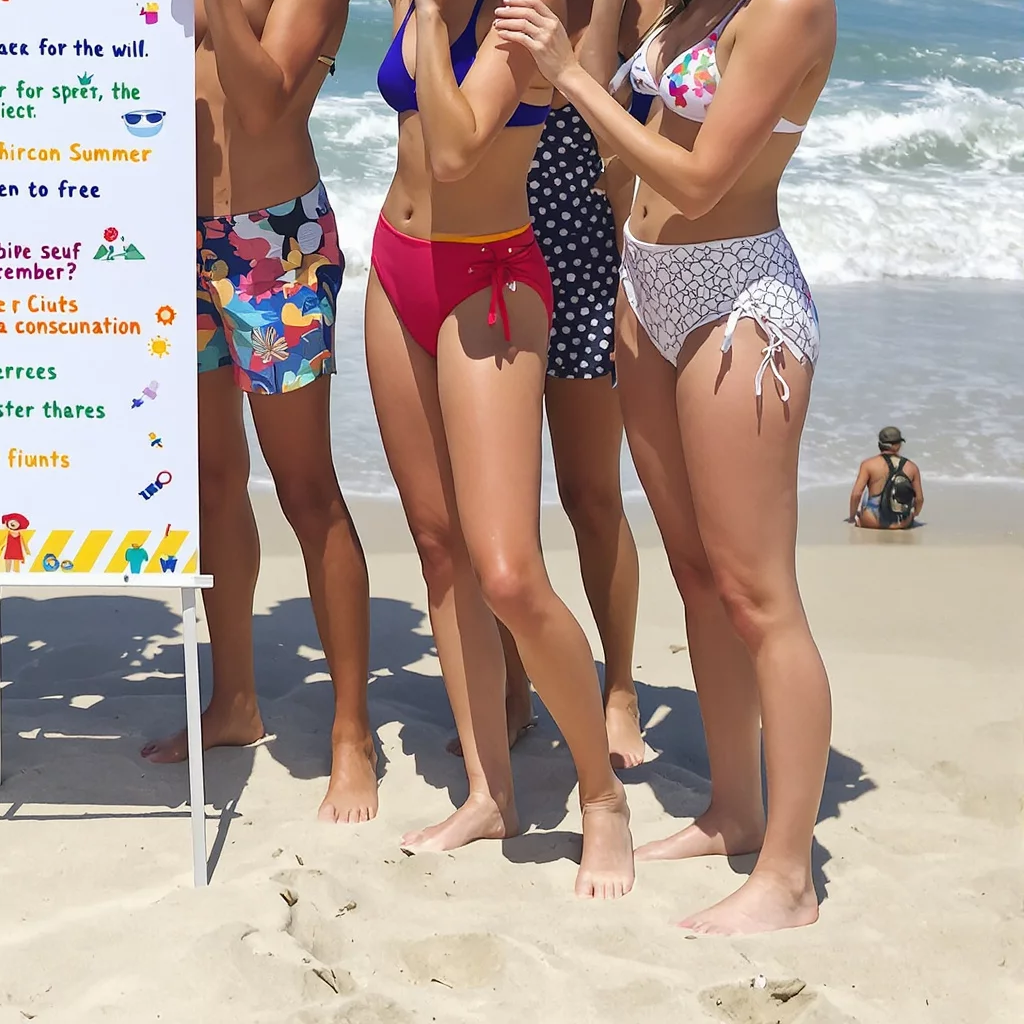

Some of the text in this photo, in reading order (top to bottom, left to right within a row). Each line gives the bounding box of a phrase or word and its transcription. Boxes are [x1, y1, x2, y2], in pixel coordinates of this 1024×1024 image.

[39, 39, 67, 56] for
[73, 39, 104, 57] the
[16, 82, 44, 99] for
[111, 82, 140, 100] the
[68, 142, 153, 163] Summer
[28, 182, 48, 198] to
[58, 180, 100, 198] free
[42, 400, 105, 419] thares
